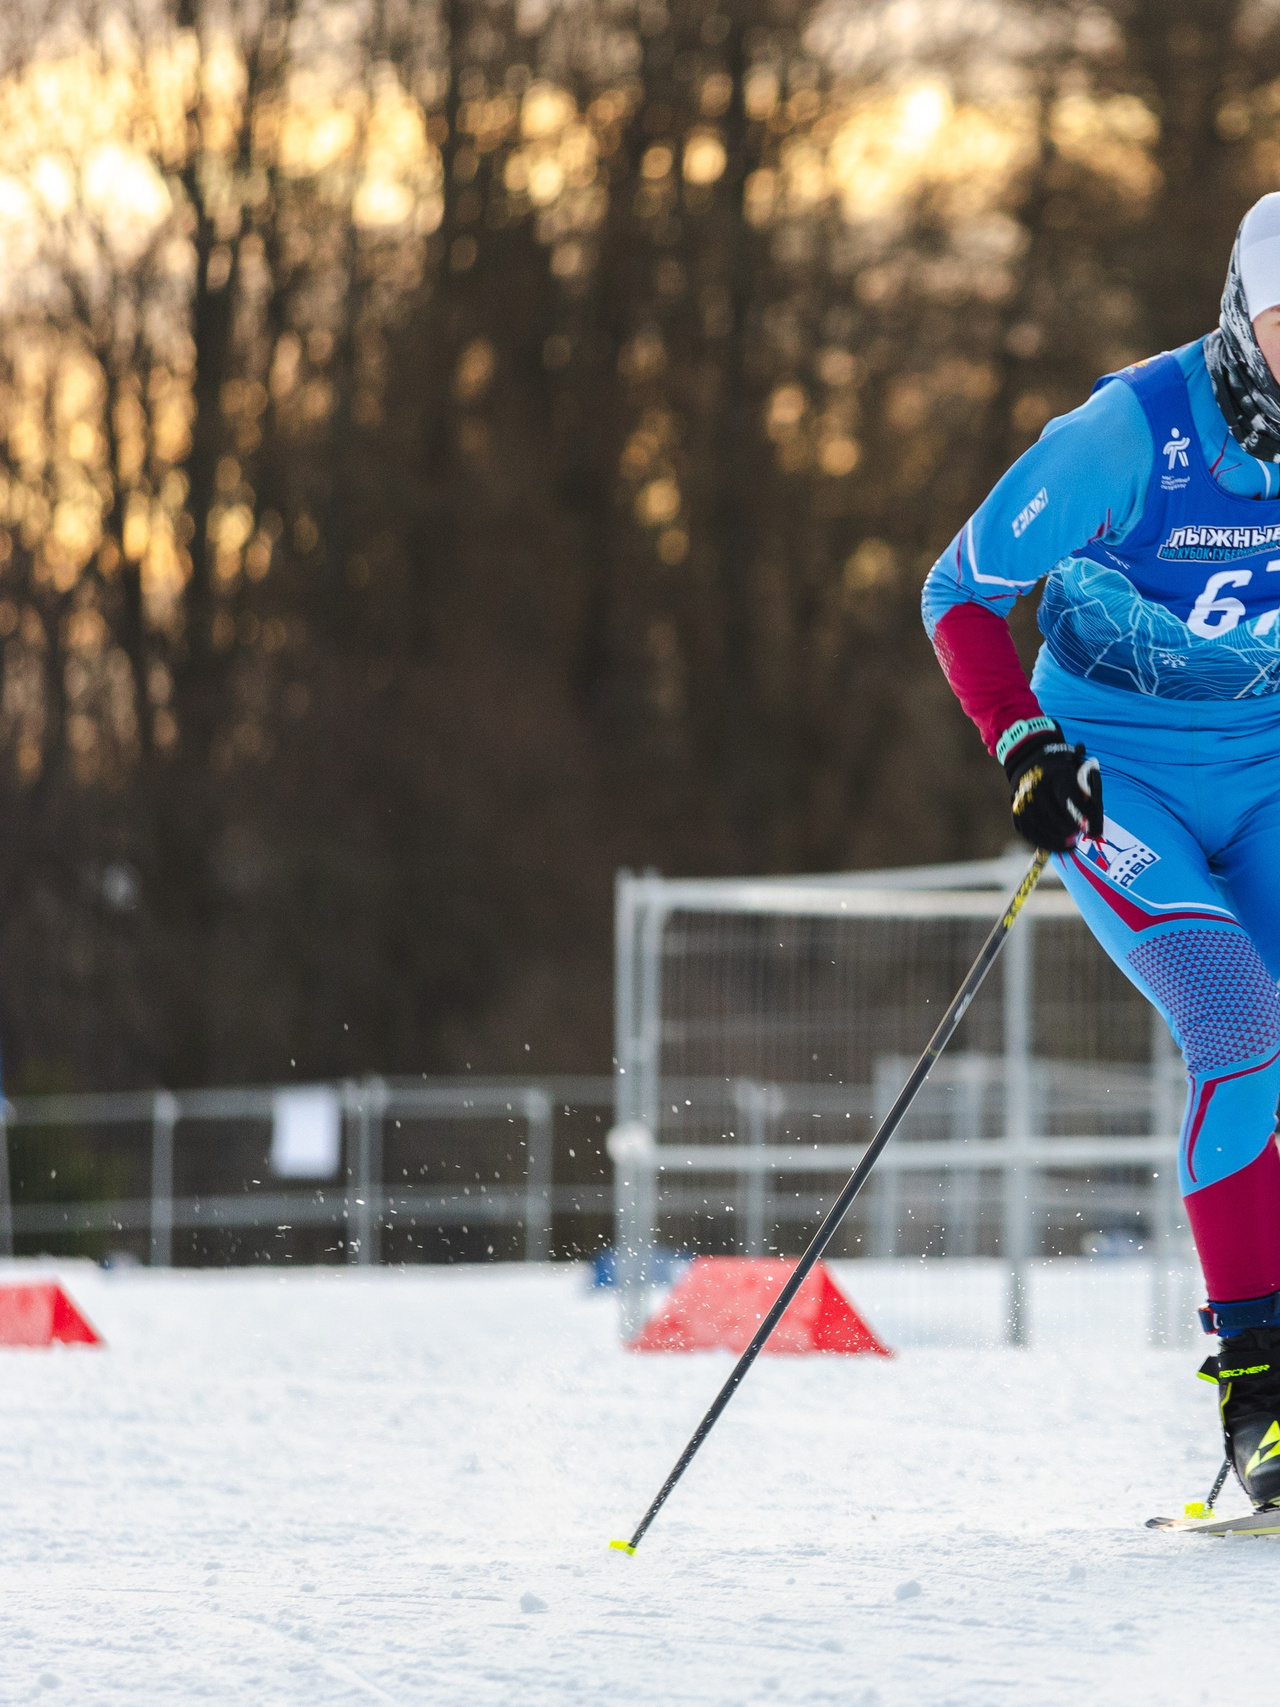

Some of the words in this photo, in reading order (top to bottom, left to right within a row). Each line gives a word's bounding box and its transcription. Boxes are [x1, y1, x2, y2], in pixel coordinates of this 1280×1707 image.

[1160, 546, 1176, 558] НА
[1177, 546, 1210, 560] КУБОК
[1120, 852, 1157, 888] RBU
